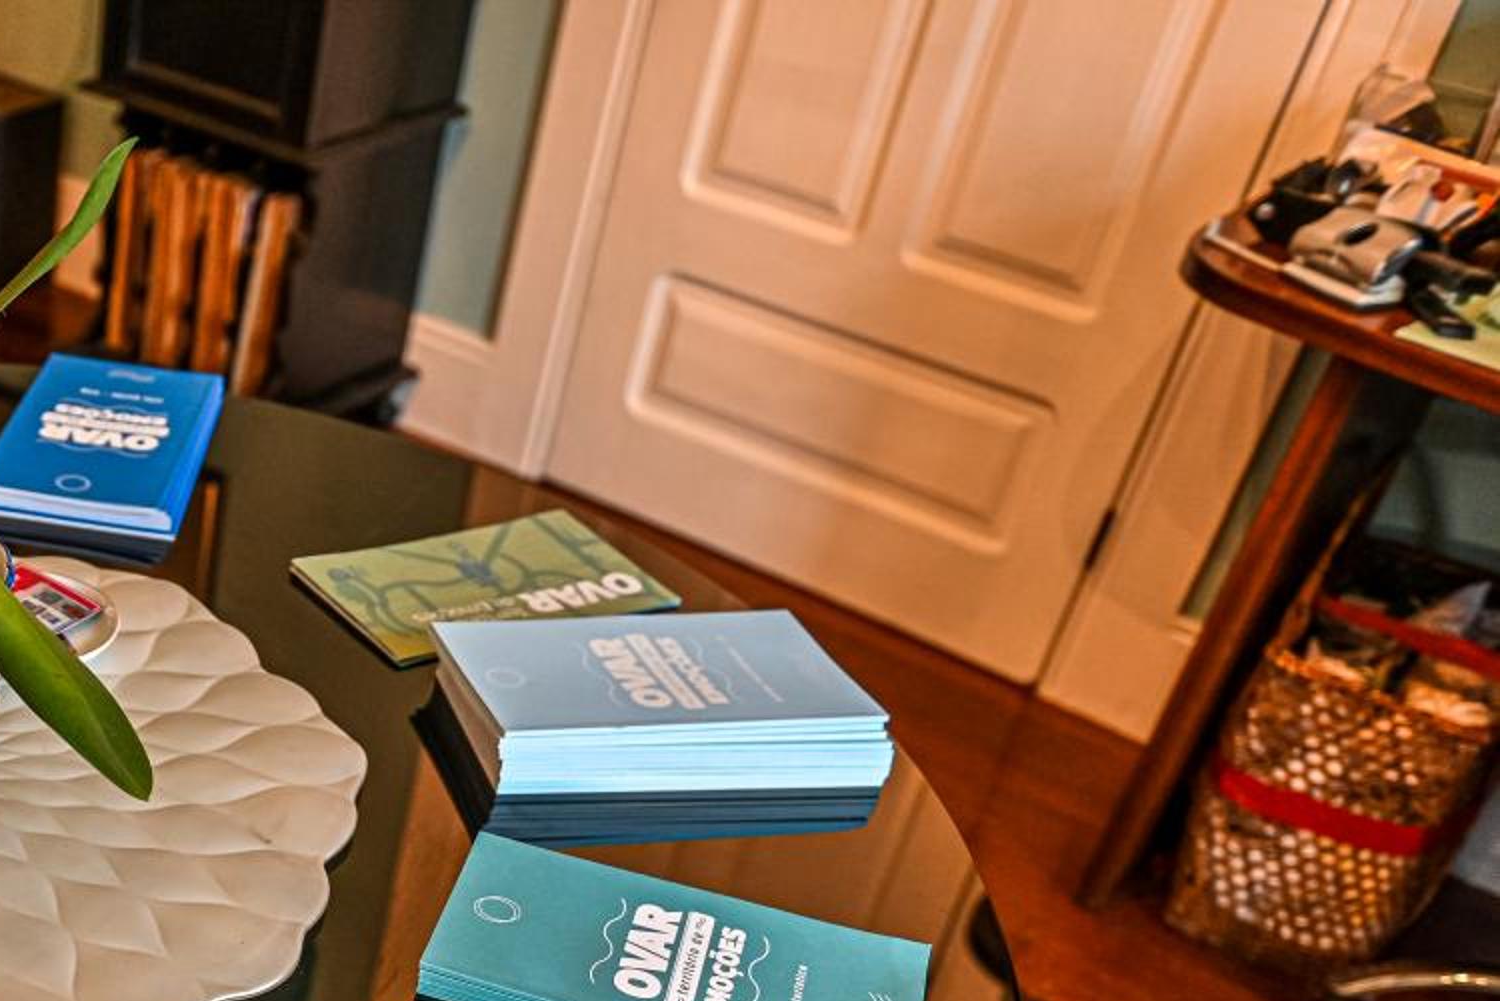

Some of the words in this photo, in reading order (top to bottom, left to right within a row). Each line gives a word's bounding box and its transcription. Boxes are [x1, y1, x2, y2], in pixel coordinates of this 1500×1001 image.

[38, 420, 160, 451] OVAR
[516, 571, 642, 612] OVAR
[589, 636, 674, 709] OVAR
[613, 903, 683, 999] OVAR
